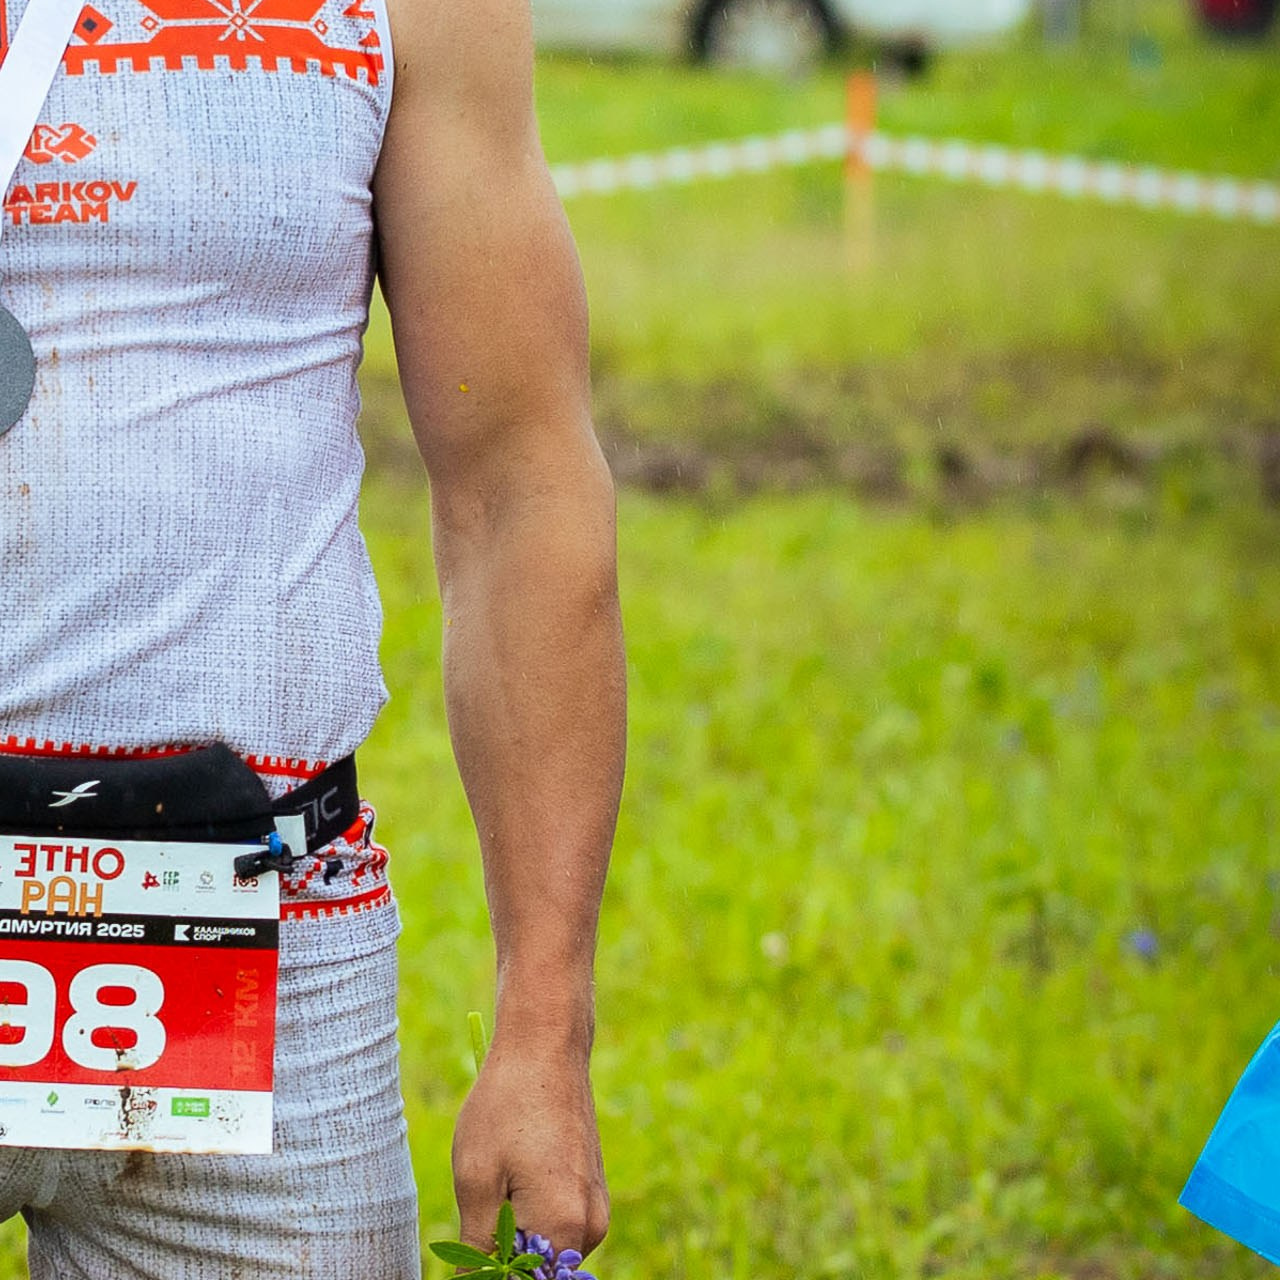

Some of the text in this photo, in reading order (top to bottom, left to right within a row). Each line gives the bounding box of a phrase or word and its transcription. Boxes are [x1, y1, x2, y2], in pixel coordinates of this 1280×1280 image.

[3, 181, 138, 206] ARKOV
[5, 202, 109, 226] TEAM
[14, 843, 125, 881] ЭТНО
[20, 875, 104, 918] РАН
[96, 923, 146, 938] 2025
